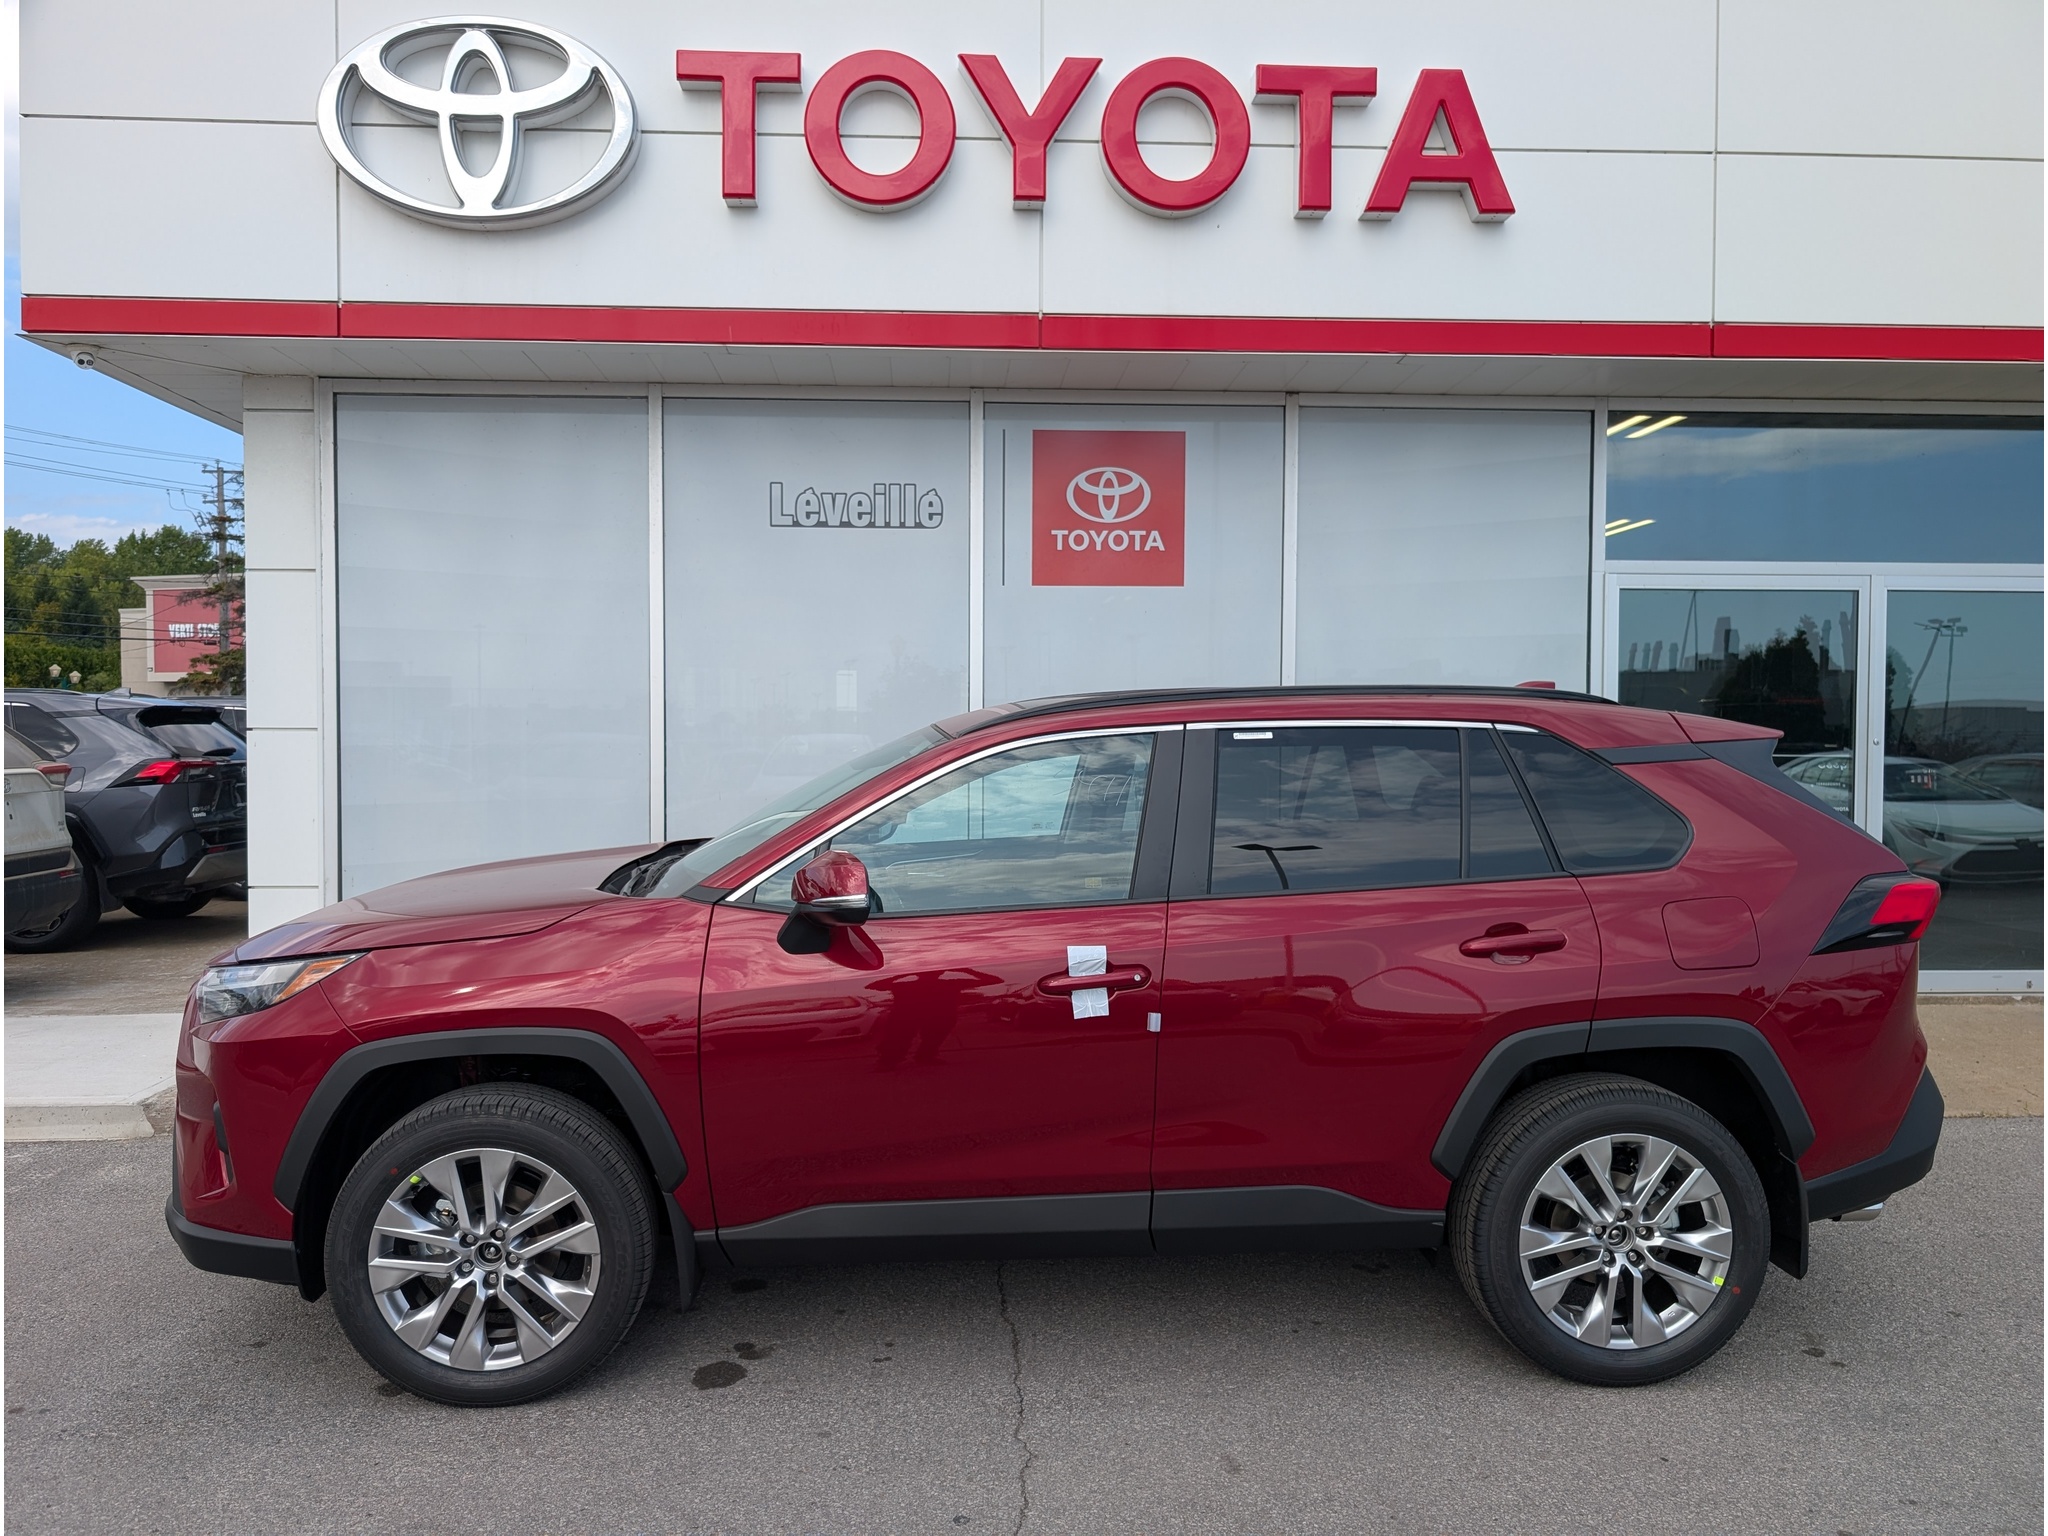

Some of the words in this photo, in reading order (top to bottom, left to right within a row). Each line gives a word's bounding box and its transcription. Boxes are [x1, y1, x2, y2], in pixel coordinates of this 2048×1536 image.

[676, 49, 1516, 222] TOYOTA
[769, 481, 944, 529] Léveillé
[1050, 529, 1166, 552] TOYOTA
